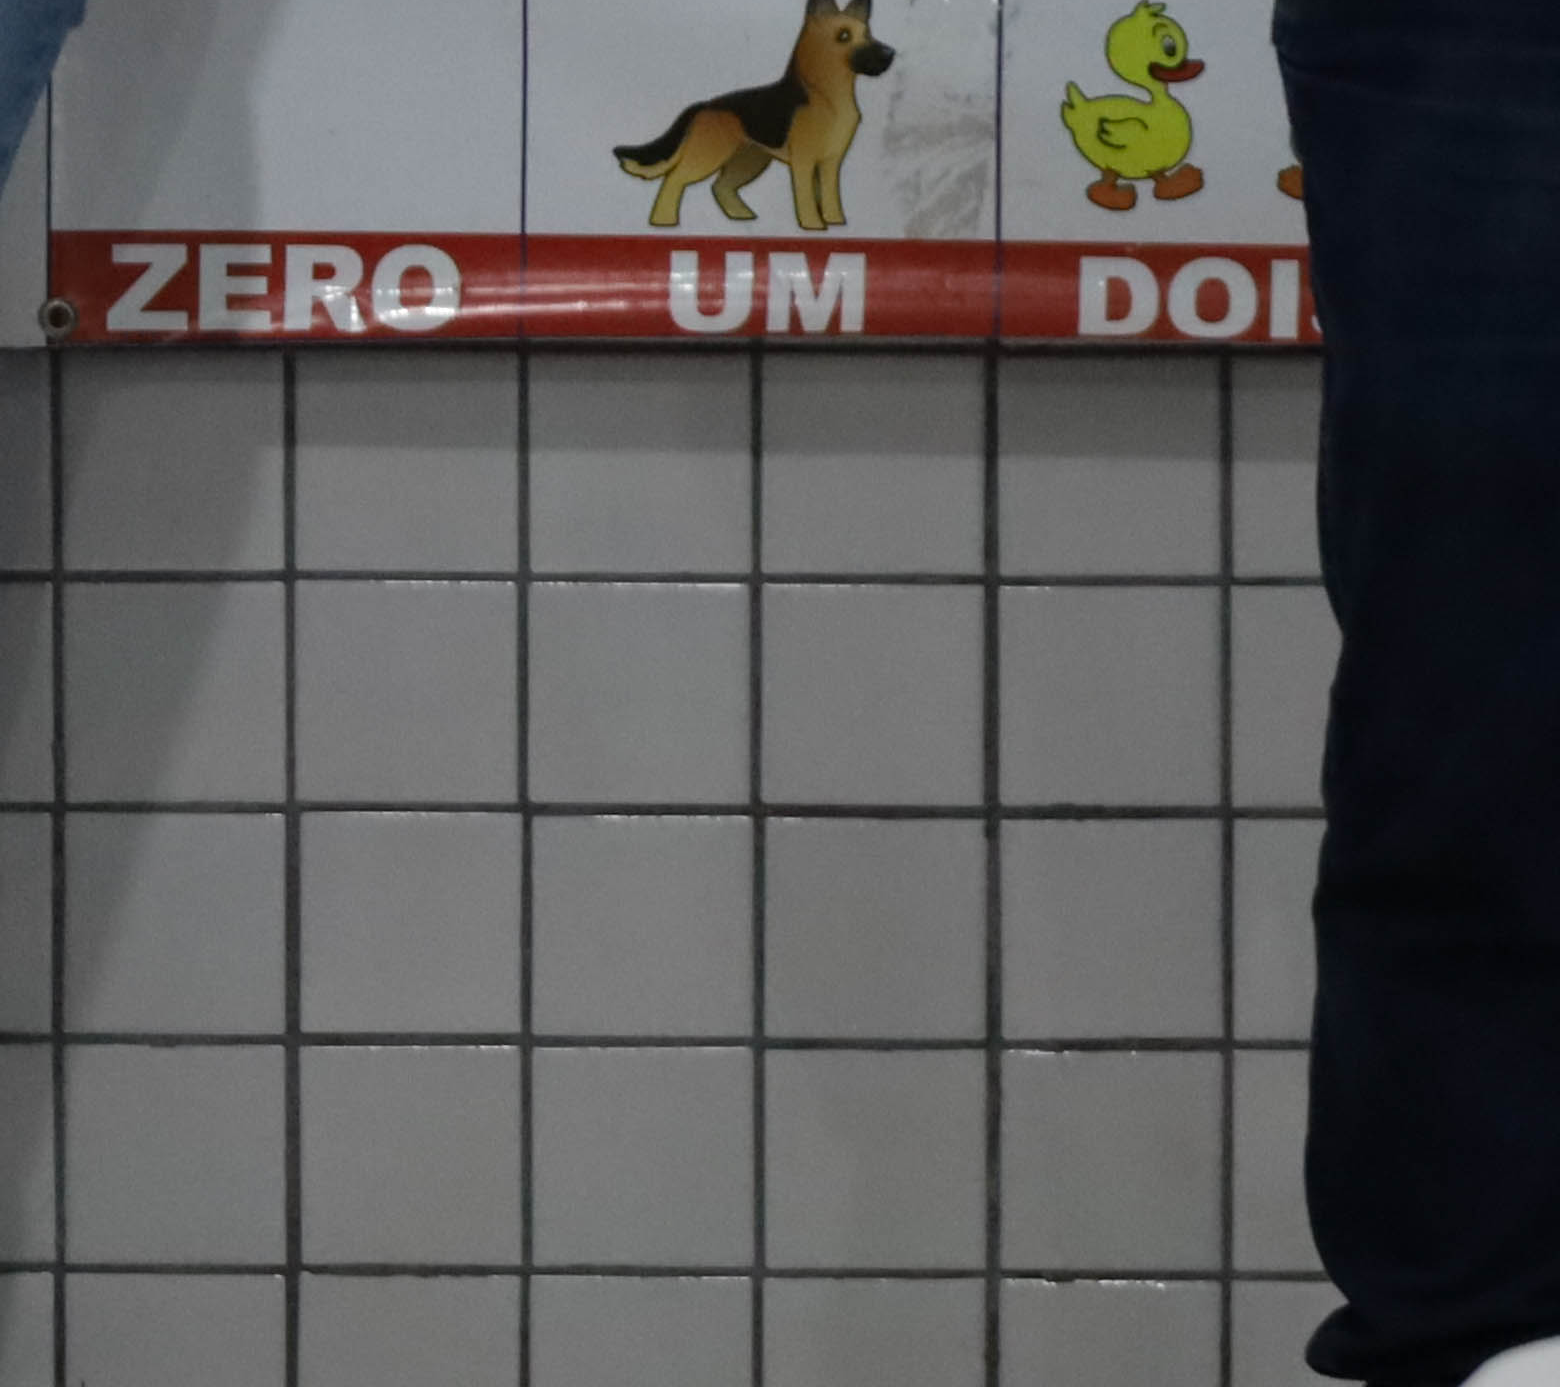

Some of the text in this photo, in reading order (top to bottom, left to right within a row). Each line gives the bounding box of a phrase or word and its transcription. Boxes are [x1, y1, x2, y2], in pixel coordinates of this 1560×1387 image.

[104, 241, 464, 335] ZERO
[666, 249, 868, 335] UM
[1077, 255, 1323, 339] DOI
